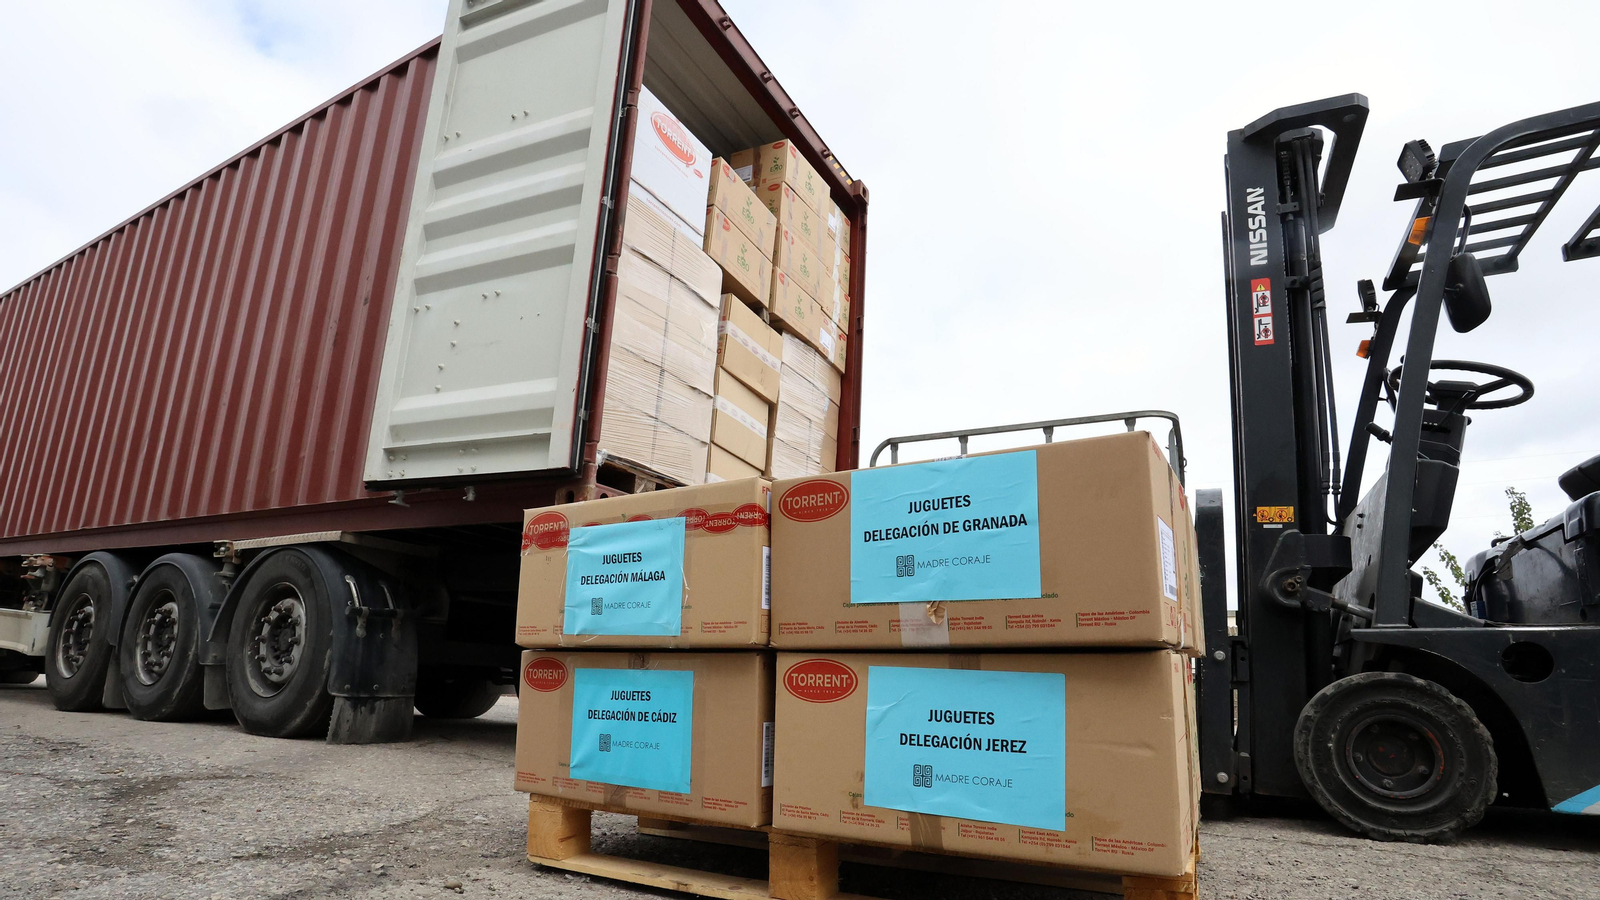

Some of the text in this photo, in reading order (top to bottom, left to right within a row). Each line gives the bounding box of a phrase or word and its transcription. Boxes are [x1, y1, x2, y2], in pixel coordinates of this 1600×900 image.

[655, 118, 692, 157] TORRENT
[1246, 187, 1268, 266] NISSAN
[786, 491, 840, 510] TORRENT
[908, 495, 971, 514] JUGUETES
[530, 521, 564, 535] TORRENT
[705, 520, 736, 528] TORRENT
[864, 514, 1028, 542] DELEGACIÓN DE GRANADA
[602, 552, 642, 565] JUGUETES
[917, 555, 991, 569] MADRE CORAJE
[580, 569, 666, 585] DELEGACIÓN MÁLAGA
[529, 669, 563, 680] TORRENT
[791, 674, 848, 688] TORRENT
[611, 690, 651, 701] JUGUETES
[588, 708, 676, 723] DELEGACIÓN DE CÁDIZ
[928, 710, 994, 725] JUGUETES
[634, 741, 660, 750] CORAJE
[900, 734, 1026, 754] DELEGACIÓN JEREZ
[935, 774, 1012, 788] MADRE CORAJE
